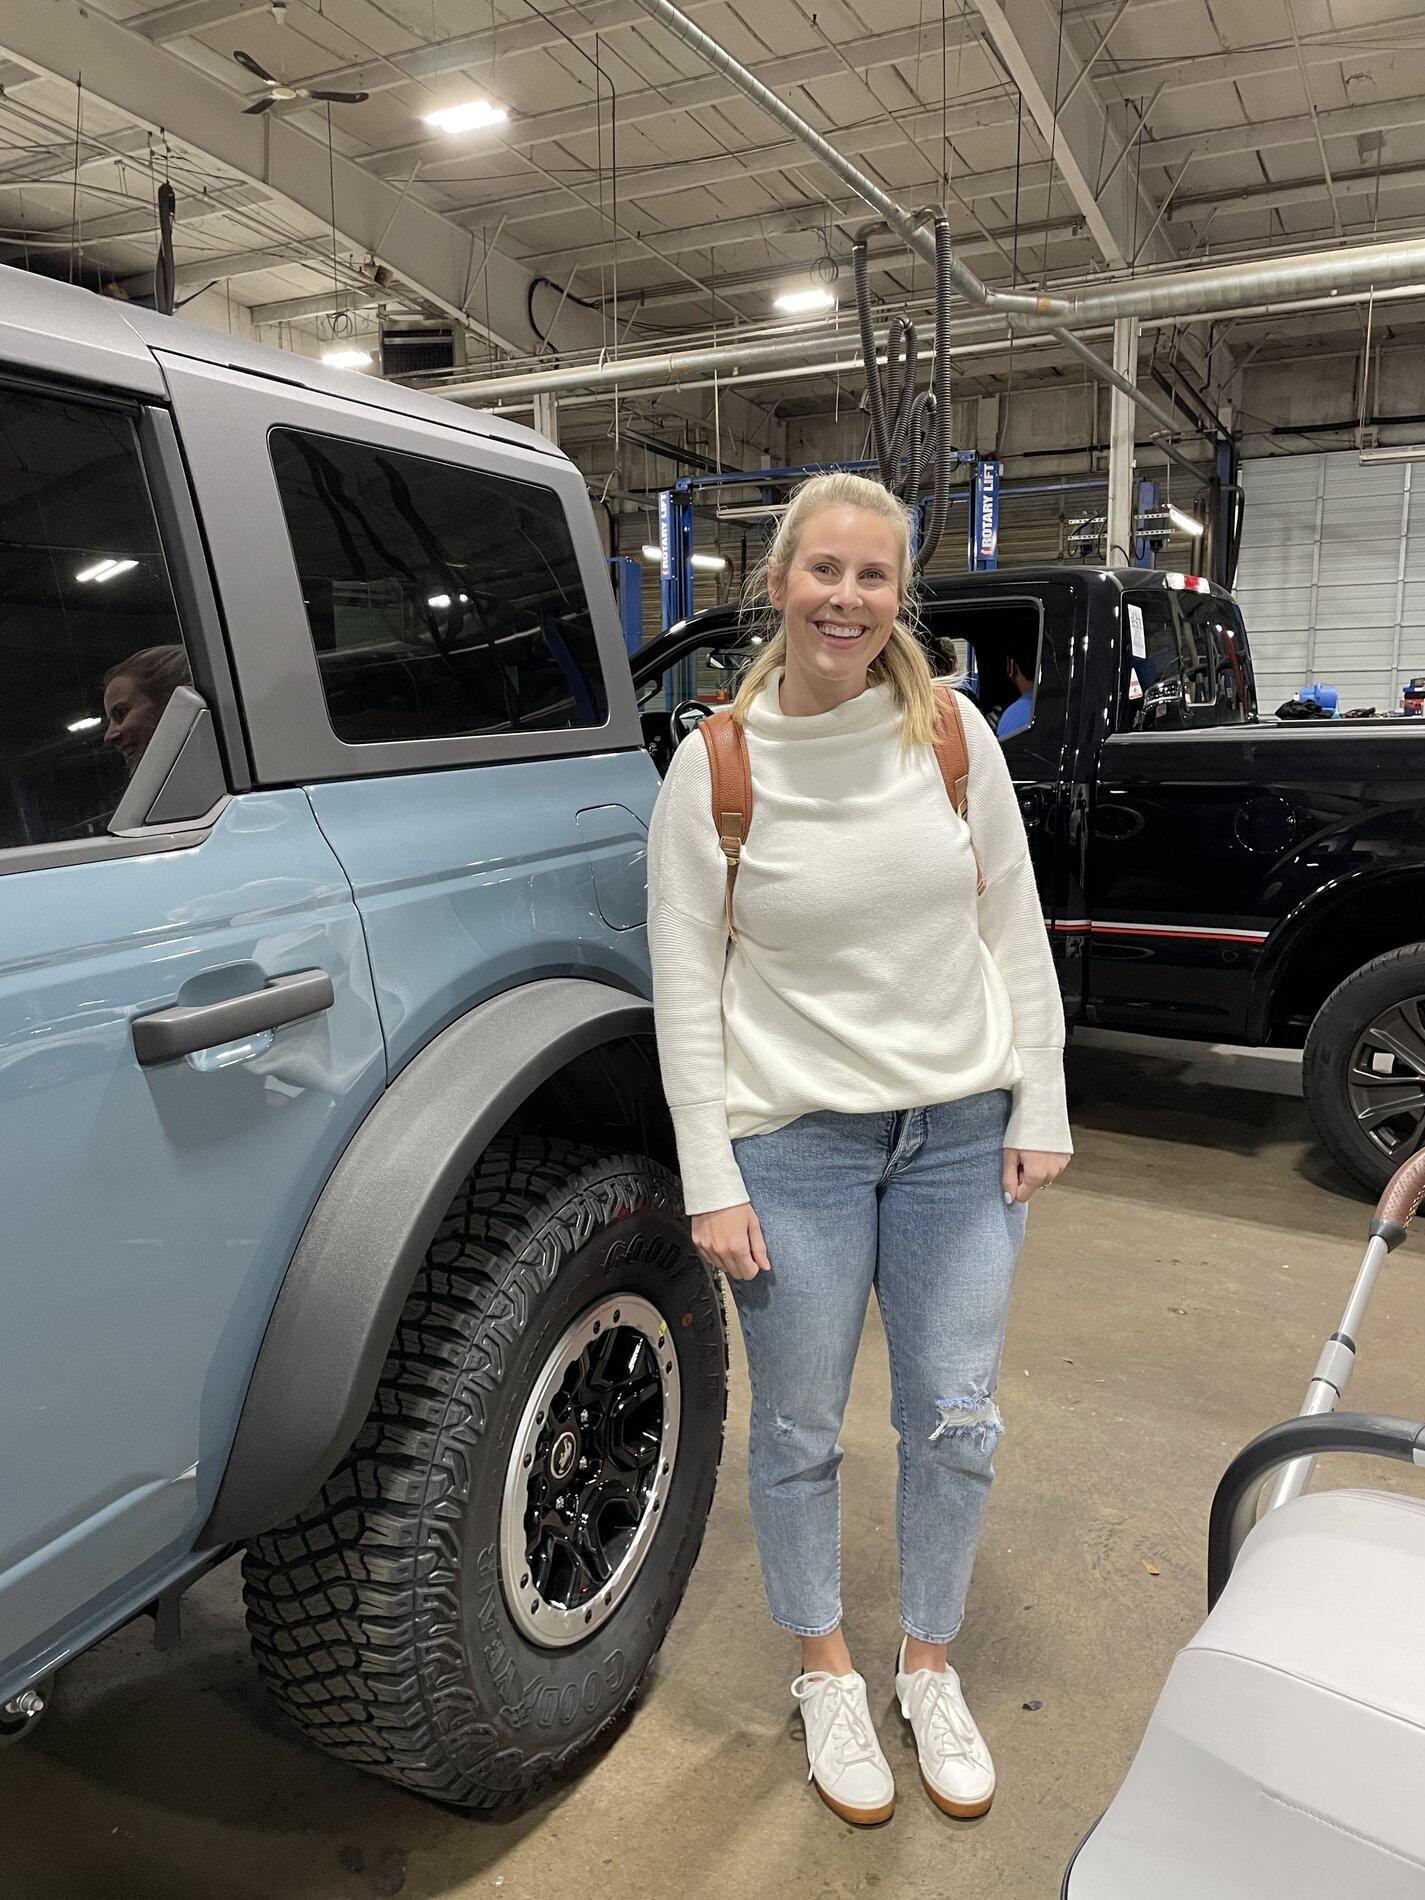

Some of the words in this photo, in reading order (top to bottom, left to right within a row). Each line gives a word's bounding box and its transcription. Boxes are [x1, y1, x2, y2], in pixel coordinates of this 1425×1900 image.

[983, 463, 994, 492] LIFT
[981, 495, 994, 548] ROTARY
[661, 522, 669, 569] ROTARY
